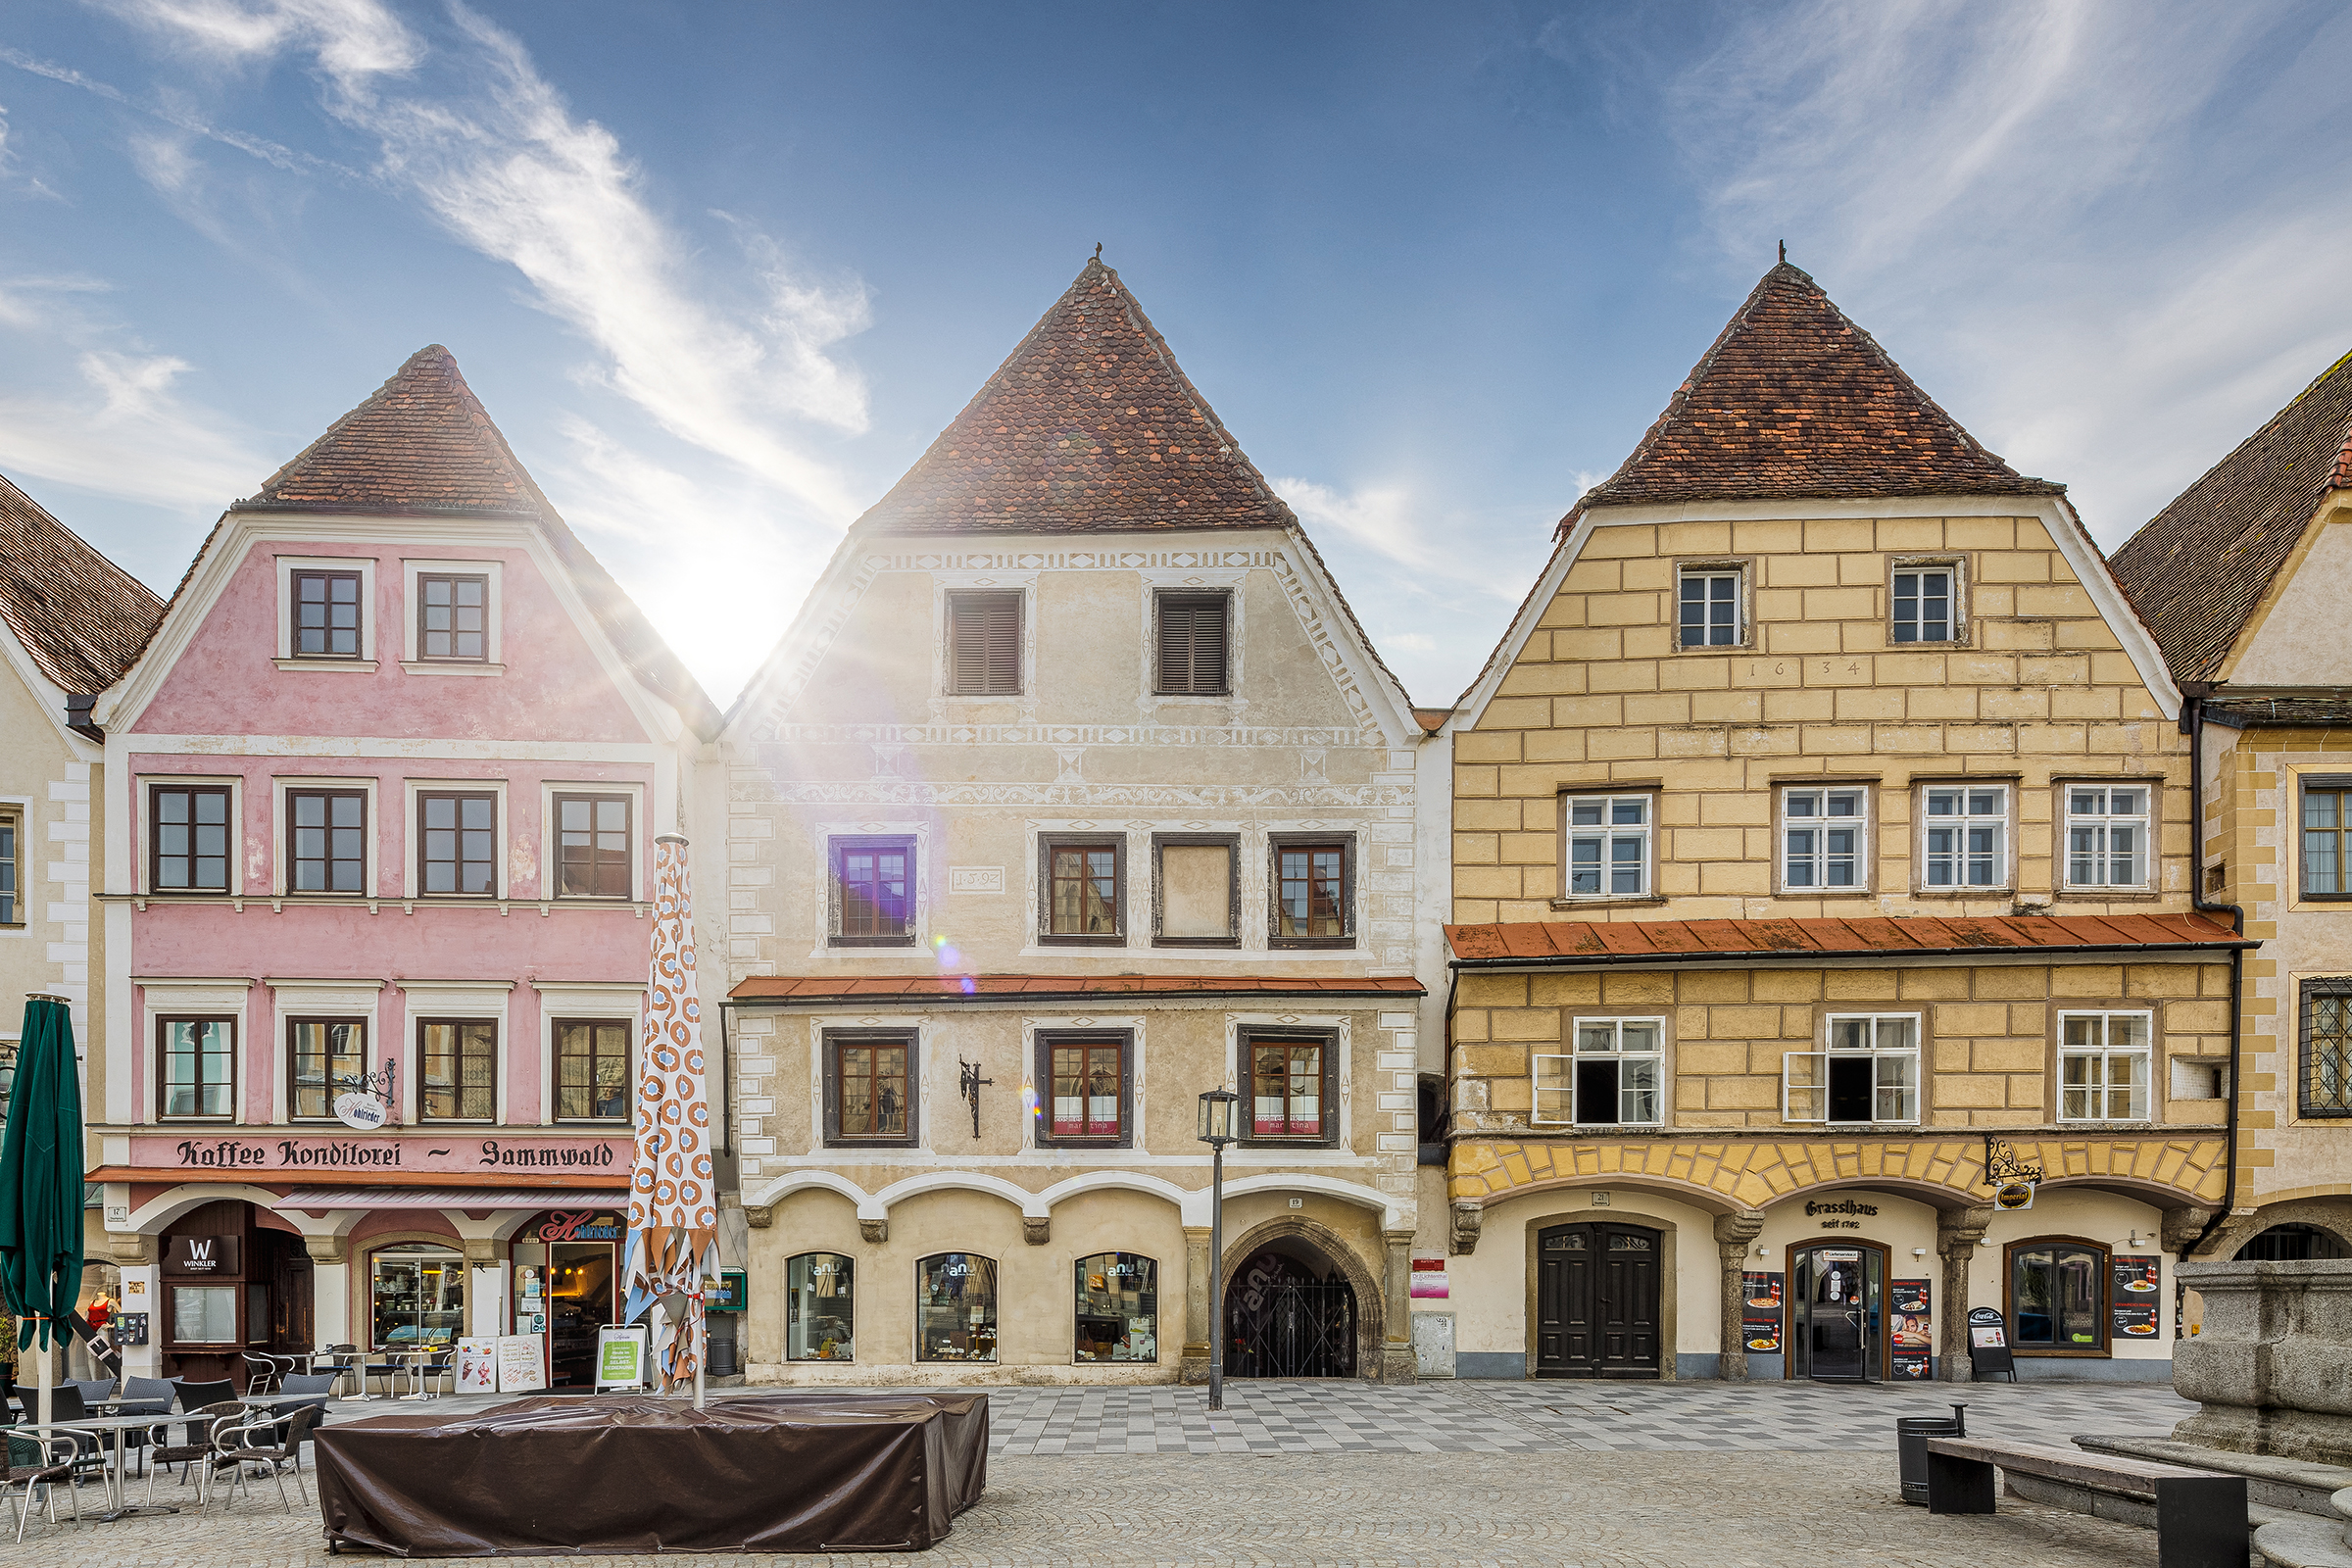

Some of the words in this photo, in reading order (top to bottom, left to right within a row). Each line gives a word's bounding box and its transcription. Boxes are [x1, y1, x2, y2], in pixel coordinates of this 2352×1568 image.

[177, 1140, 266, 1168] Kaffee
[277, 1140, 402, 1166] Konditorei
[479, 1141, 613, 1166] Sammwald
[2000, 1192, 2028, 1200] Imperial
[1805, 1200, 1879, 1216] Grasslhaus
[539, 1208, 618, 1242] Hohlrieder
[1821, 1219, 1840, 1229] seit
[189, 1239, 212, 1260] W
[941, 1262, 975, 1276] nanu
[1099, 1262, 1134, 1276] nanu
